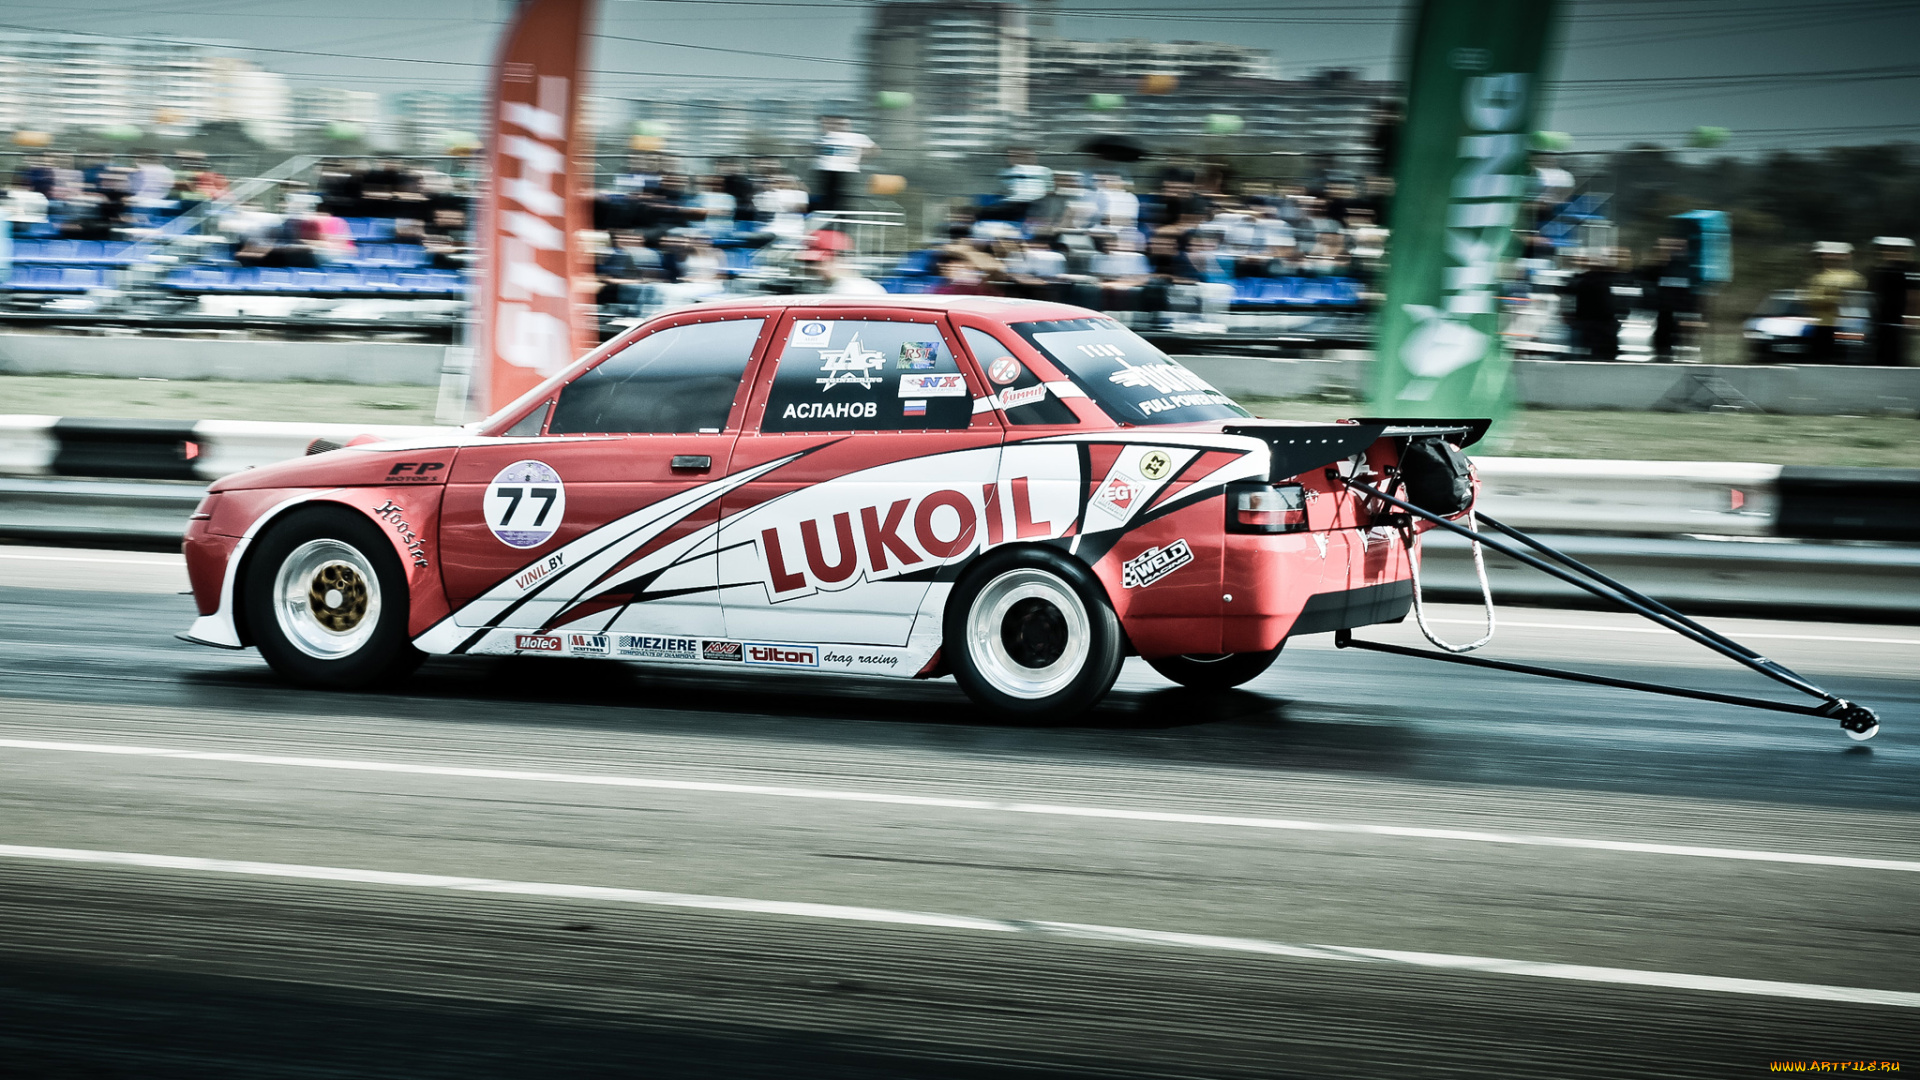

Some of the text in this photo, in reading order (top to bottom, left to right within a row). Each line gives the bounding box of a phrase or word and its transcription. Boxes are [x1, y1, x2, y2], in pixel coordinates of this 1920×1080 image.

[920, 376, 960, 387] NX
[783, 402, 877, 418] АСЛАНОВ
[1138, 397, 1176, 415] FULL
[389, 463, 445, 475] FP
[497, 488, 557, 527] 77
[762, 476, 1052, 593] LUKOIL
[1134, 543, 1187, 577] WELD
[516, 553, 564, 589] VINIL.BY
[1143, 554, 1190, 584] RACING
[520, 636, 558, 649] MoTeC
[631, 636, 697, 651] MEZIERE
[749, 647, 814, 663] tilton
[824, 651, 898, 668] drag racing
